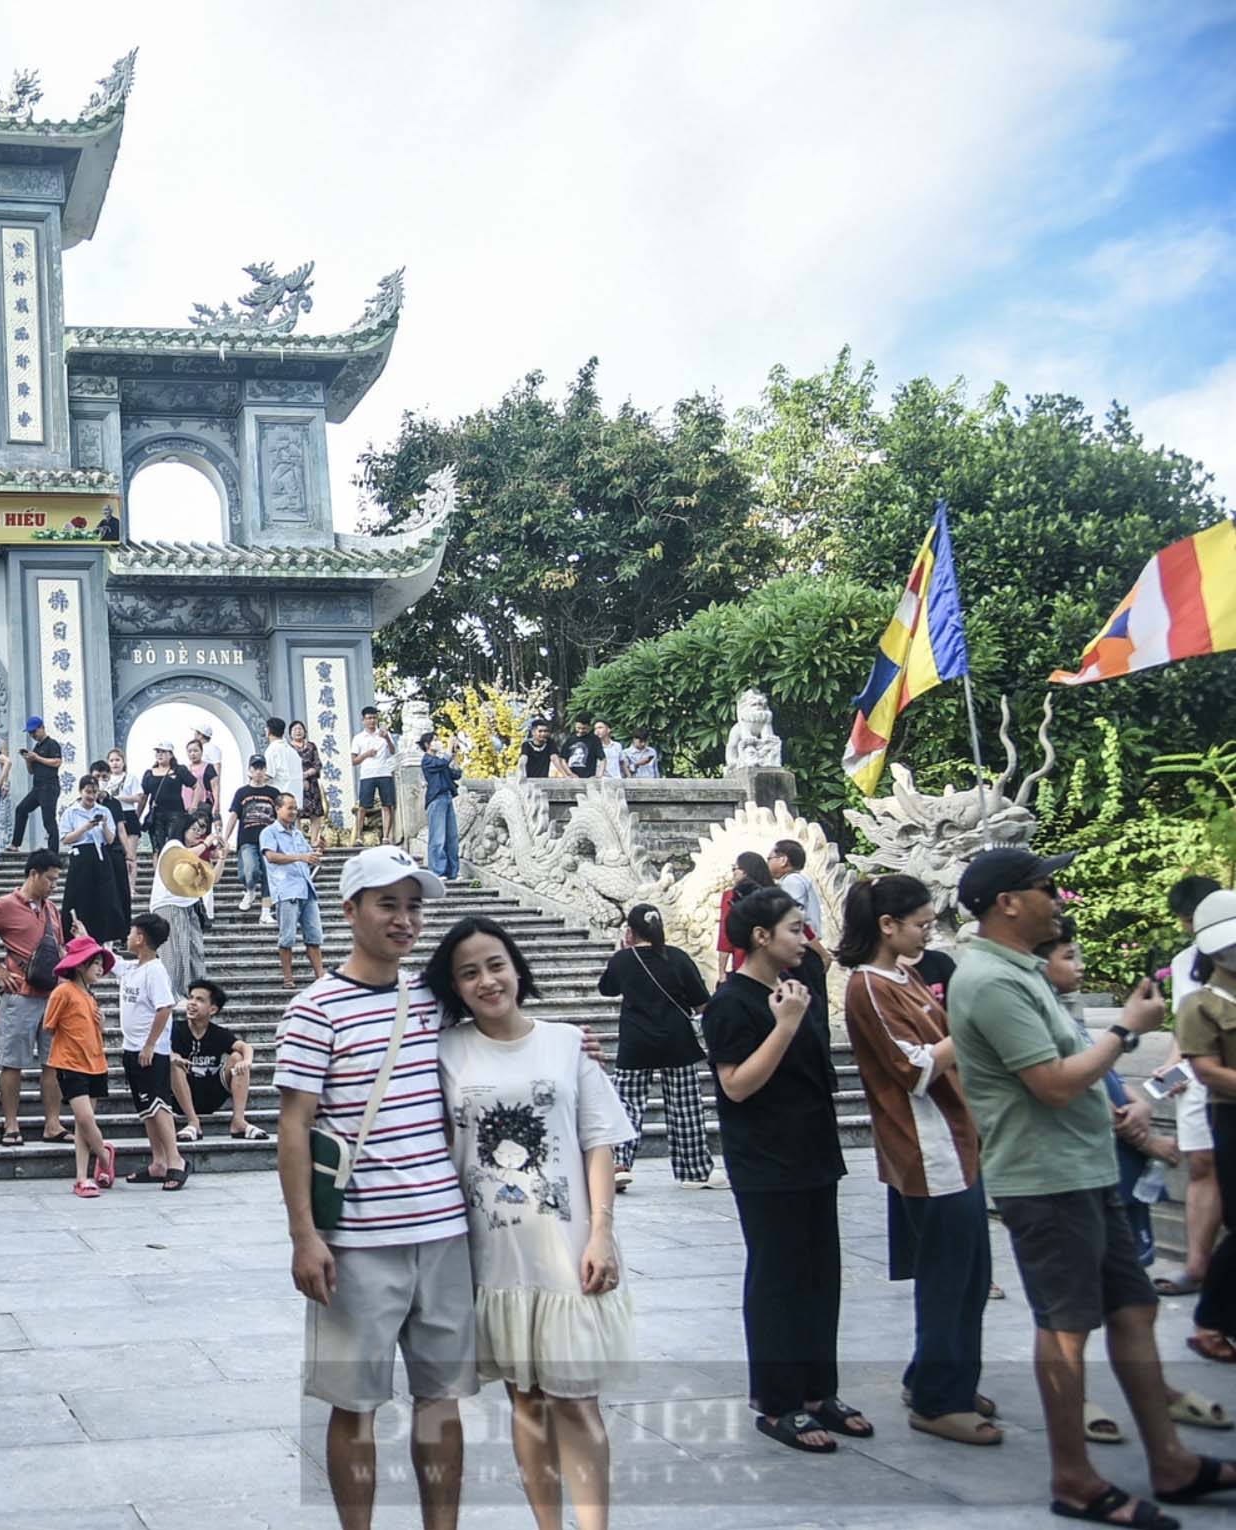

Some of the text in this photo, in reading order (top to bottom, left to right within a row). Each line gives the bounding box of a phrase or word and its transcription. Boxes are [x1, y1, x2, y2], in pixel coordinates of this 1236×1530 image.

[4, 508, 46, 527] HIẾU
[132, 641, 244, 665] BỒ ĐỀ SANH
